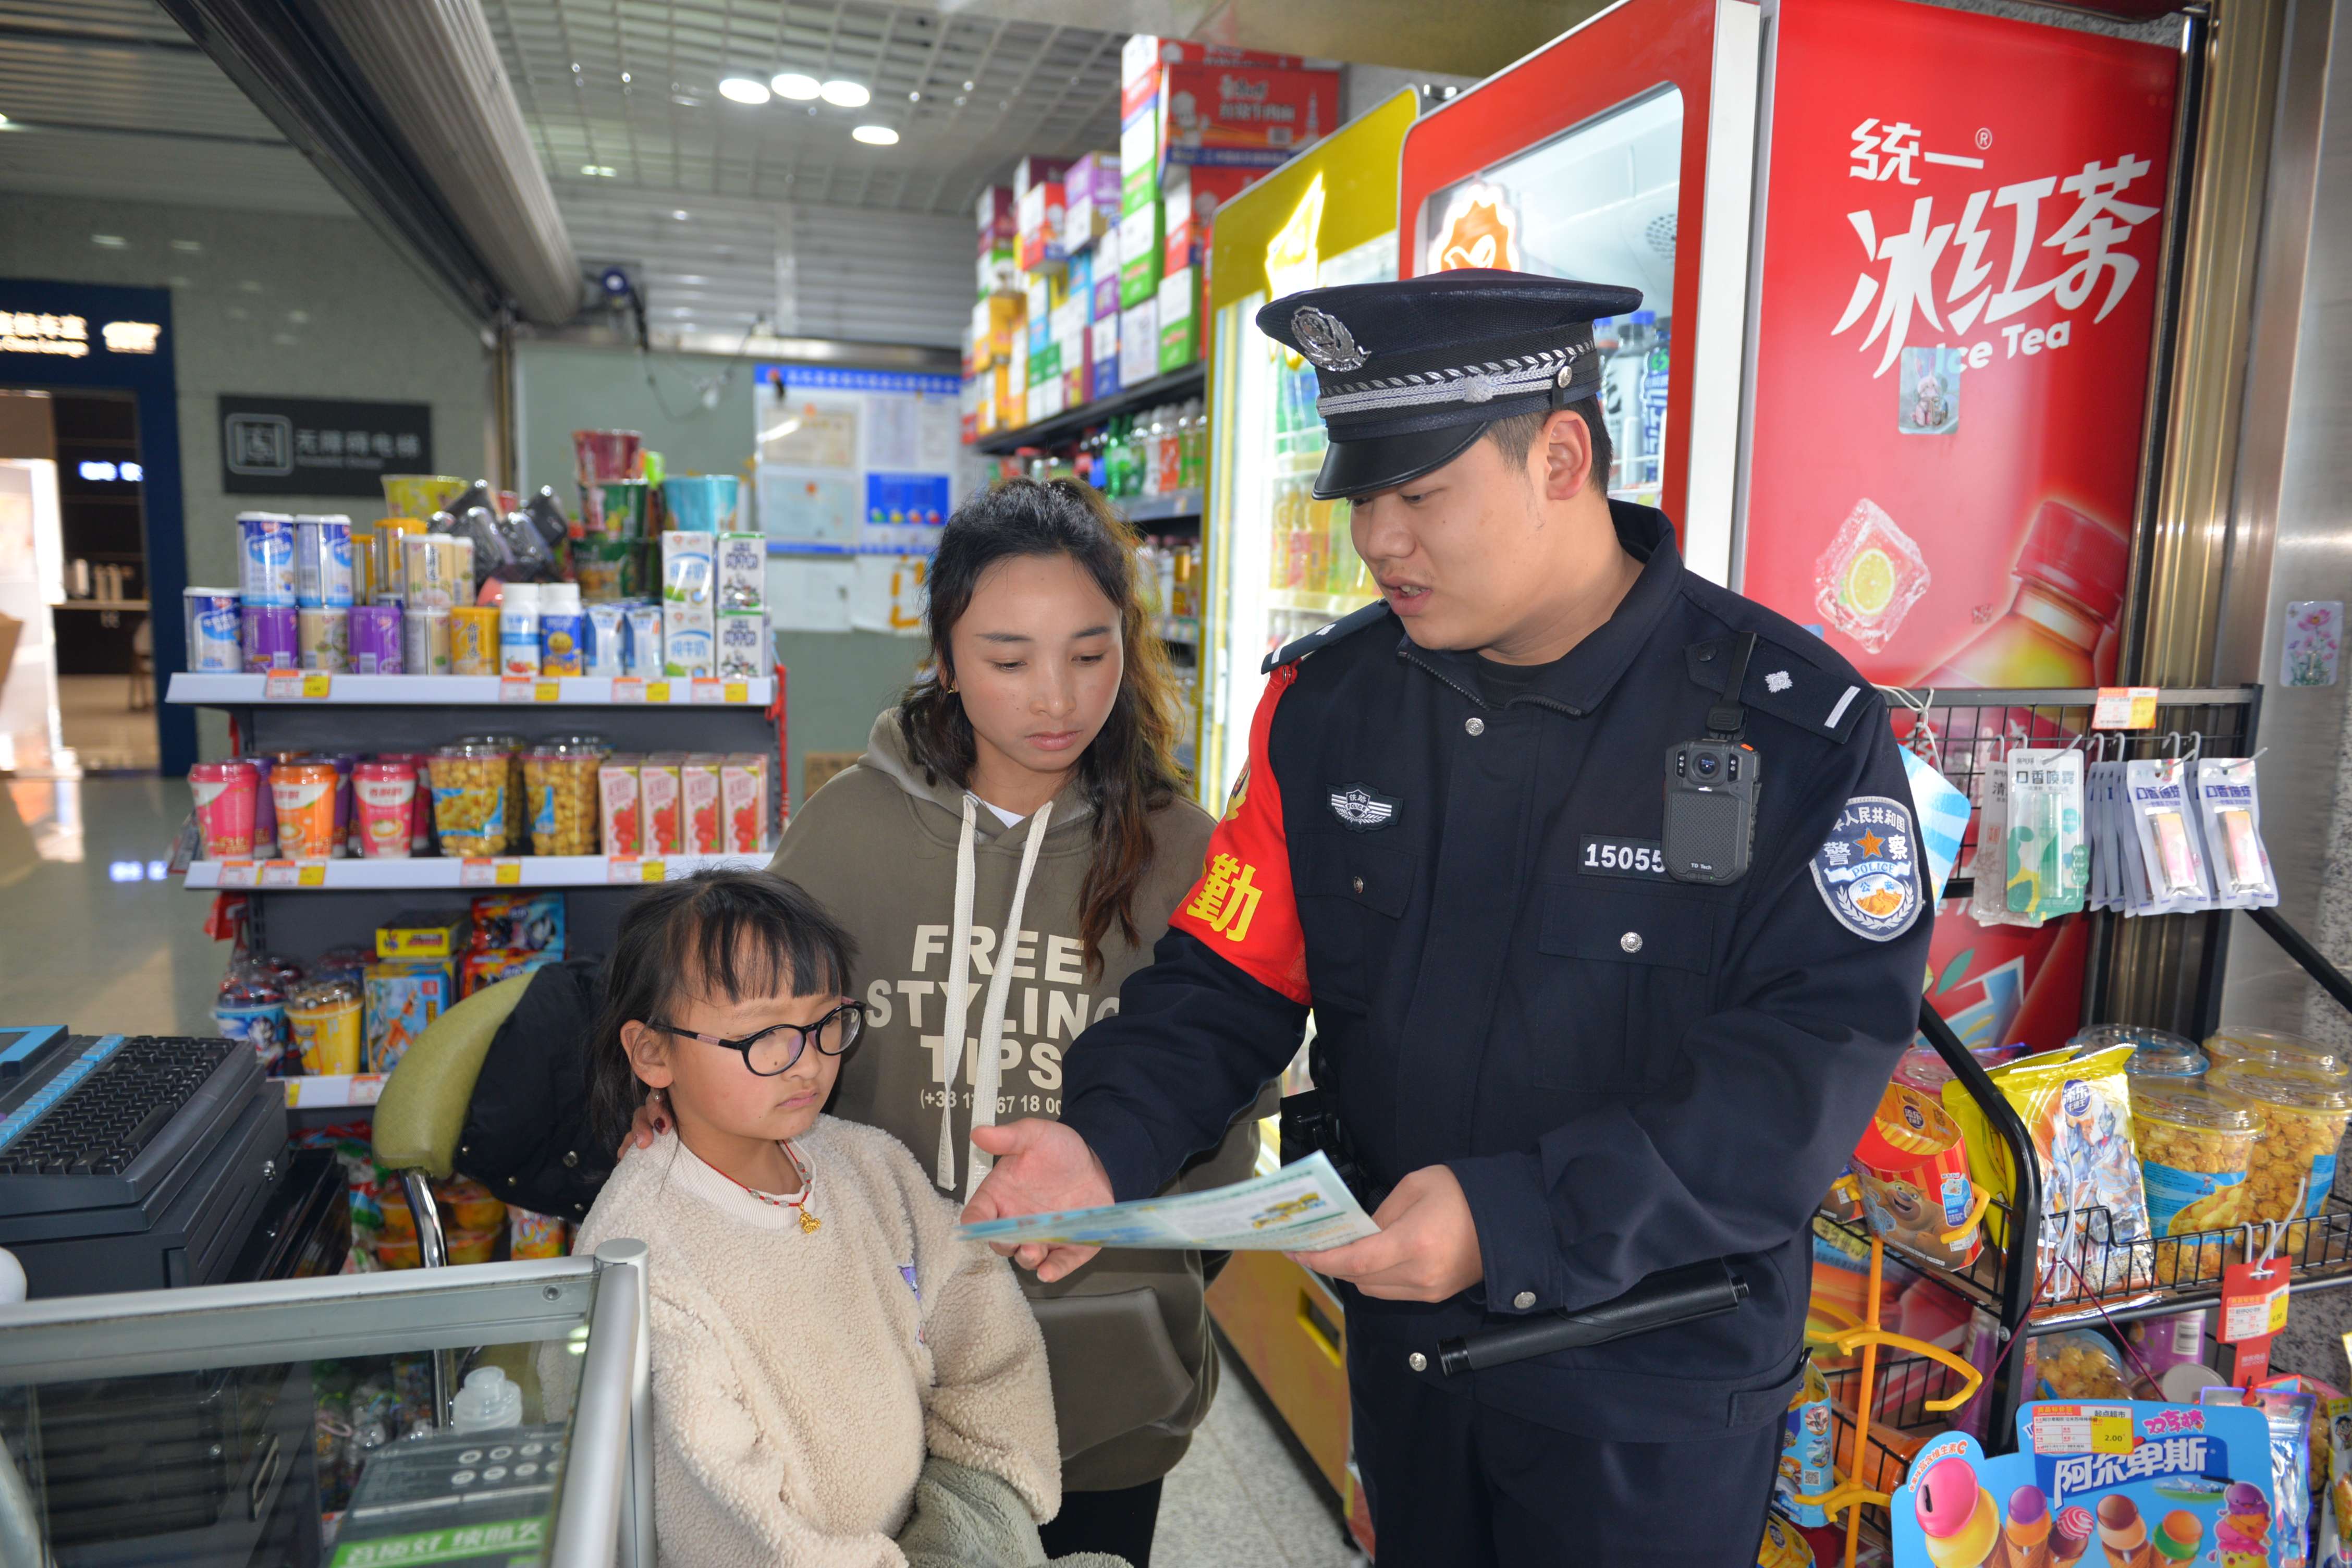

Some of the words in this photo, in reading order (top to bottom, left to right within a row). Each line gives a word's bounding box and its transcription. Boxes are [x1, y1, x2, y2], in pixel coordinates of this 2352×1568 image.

[1849, 118, 1984, 185] 统一
[1831, 153, 2161, 379] 冰红茶
[2001, 320, 2071, 360] Tea
[1349, 793, 1367, 803] 铁路
[1584, 843, 1666, 873] 15055
[1823, 841, 1852, 866] 警
[1888, 834, 1908, 860] 察
[1852, 863, 1896, 877] POLICE
[1186, 853, 1263, 942] 勤
[911, 925, 1085, 985] FREE
[920, 1035, 1062, 1090] TIPS
[1021, 1095, 1040, 1112] 18
[2094, 1410, 2126, 1418] 起点超市
[2054, 1437, 2208, 1511] 阿尔卑斯
